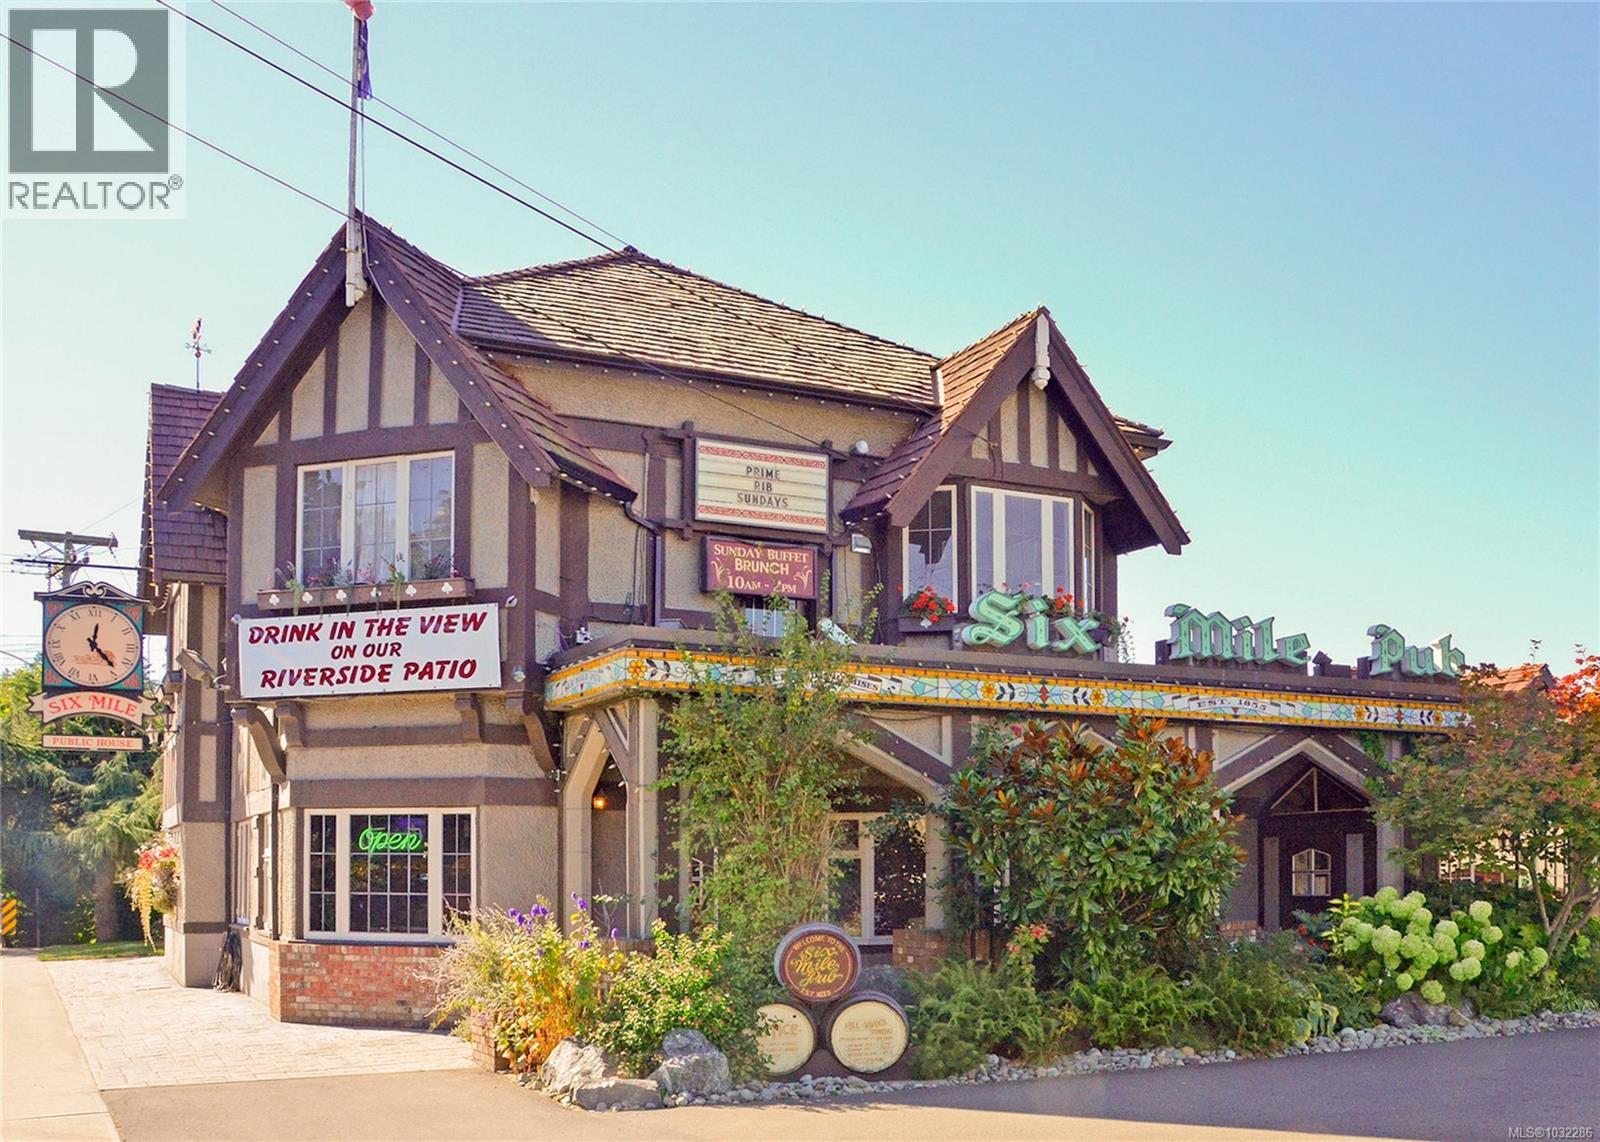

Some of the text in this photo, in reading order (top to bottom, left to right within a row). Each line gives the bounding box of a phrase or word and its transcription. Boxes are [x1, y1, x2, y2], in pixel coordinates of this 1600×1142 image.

[746, 466, 781, 480] PRIME
[754, 480, 773, 492] RIB
[737, 492, 789, 508] SUNDAYS
[714, 543, 809, 563] SUNDAY BUFFET
[735, 557, 790, 576] BRUNCH
[727, 575, 761, 591] 10AM
[247, 611, 488, 645] DRINK IN THE VIEW
[961, 589, 1466, 679] Six Mile Pub
[330, 641, 402, 661] ON OUR
[260, 658, 478, 690] RIVERSIDE PATIO
[48, 694, 138, 717] SIX MILE
[51, 736, 134, 748] PUBLIC HOUSE
[358, 827, 422, 853] Open
[800, 945, 839, 961] Six
